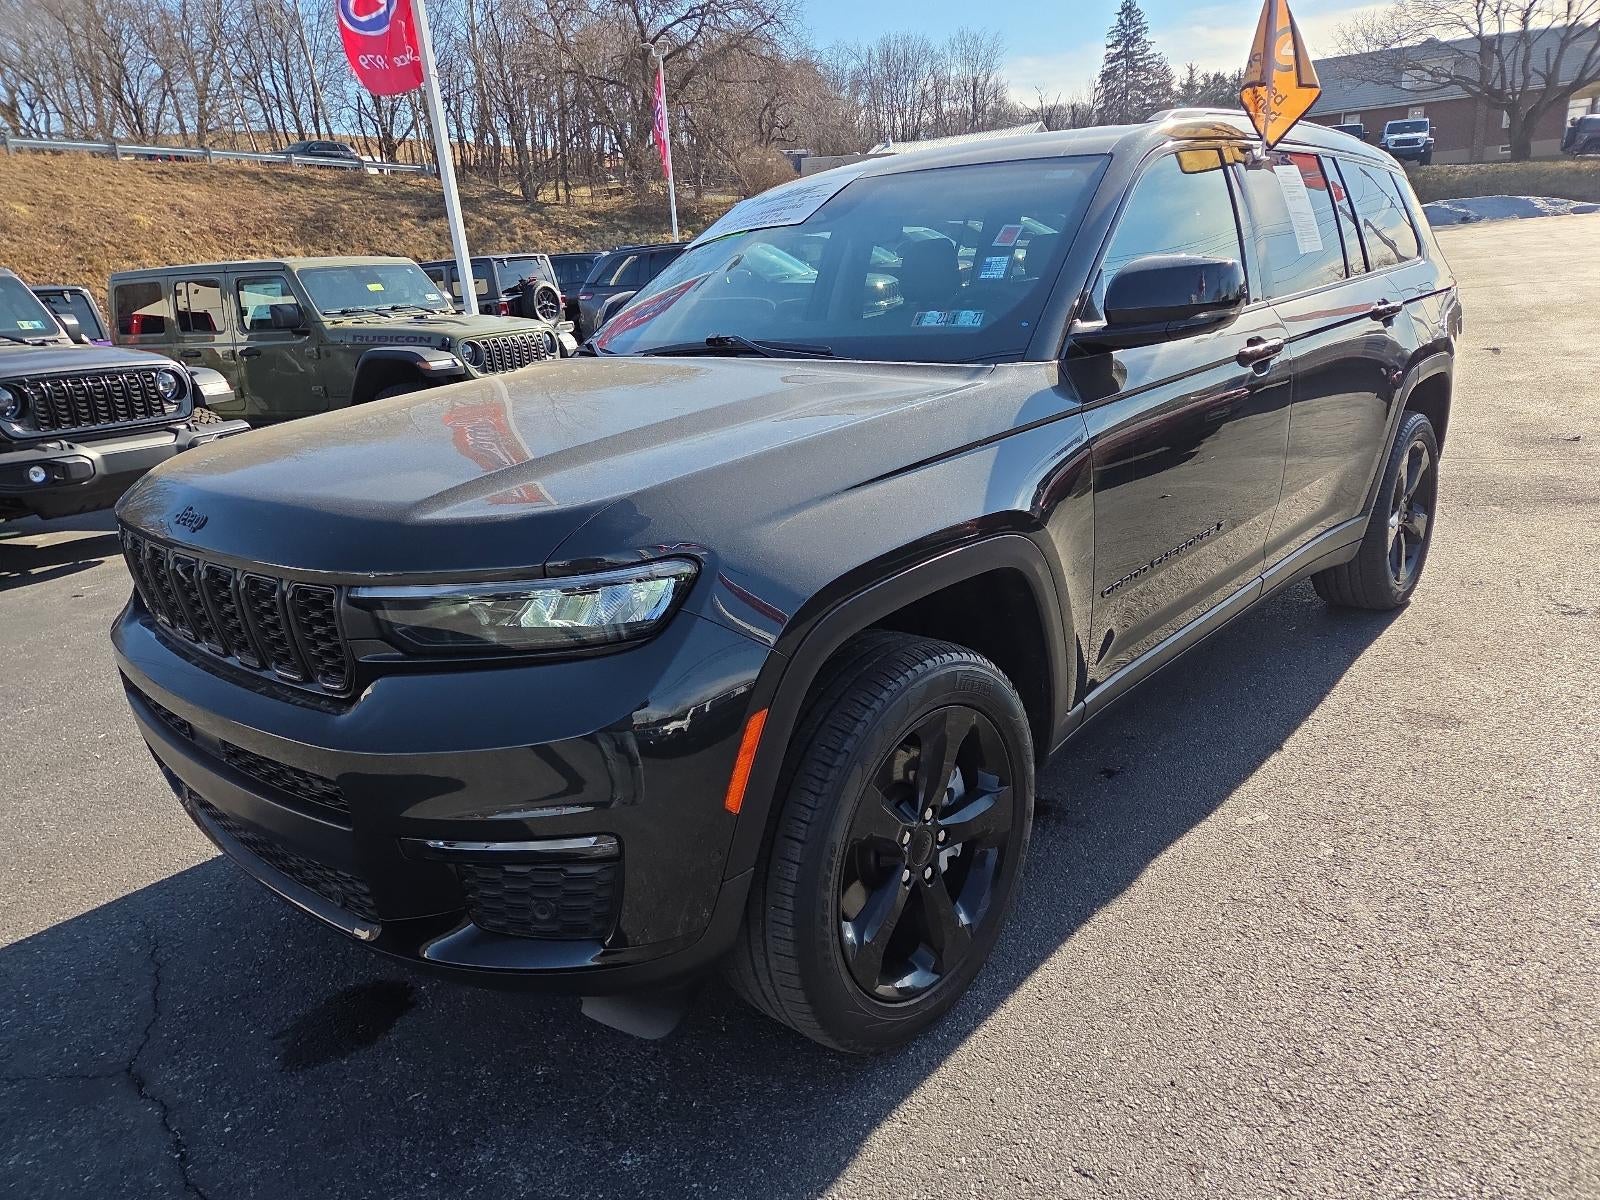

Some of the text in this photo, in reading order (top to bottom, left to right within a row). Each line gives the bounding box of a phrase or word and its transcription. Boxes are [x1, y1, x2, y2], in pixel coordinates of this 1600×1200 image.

[352, 334, 432, 344] RUBICON
[175, 504, 209, 533] Jeep
[1100, 564, 1149, 599] GRAND
[1150, 524, 1217, 568] CHEROKEE
